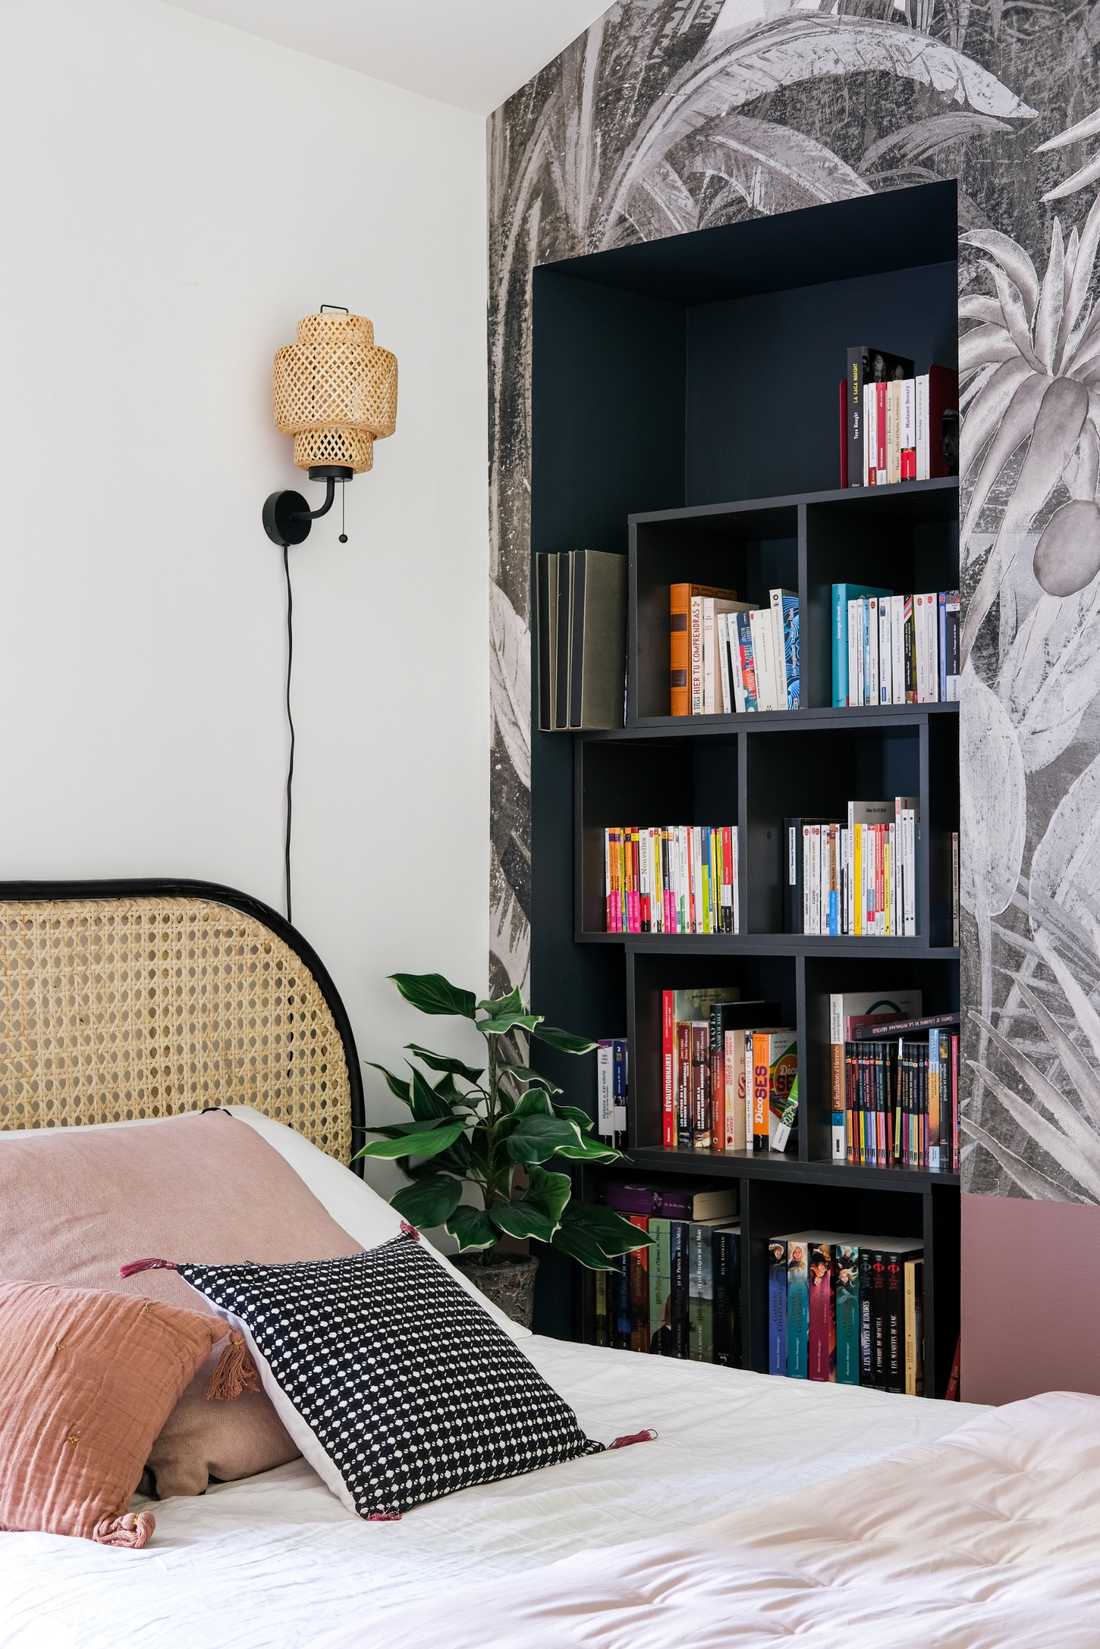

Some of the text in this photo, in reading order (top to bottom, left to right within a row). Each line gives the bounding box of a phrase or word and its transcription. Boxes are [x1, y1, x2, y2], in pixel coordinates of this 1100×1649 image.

[692, 609, 700, 662] COMPRENDRAS
[692, 665, 700, 674] TU
[692, 678, 700, 694] HIER
[754, 1066, 768, 1123] Dico SES
